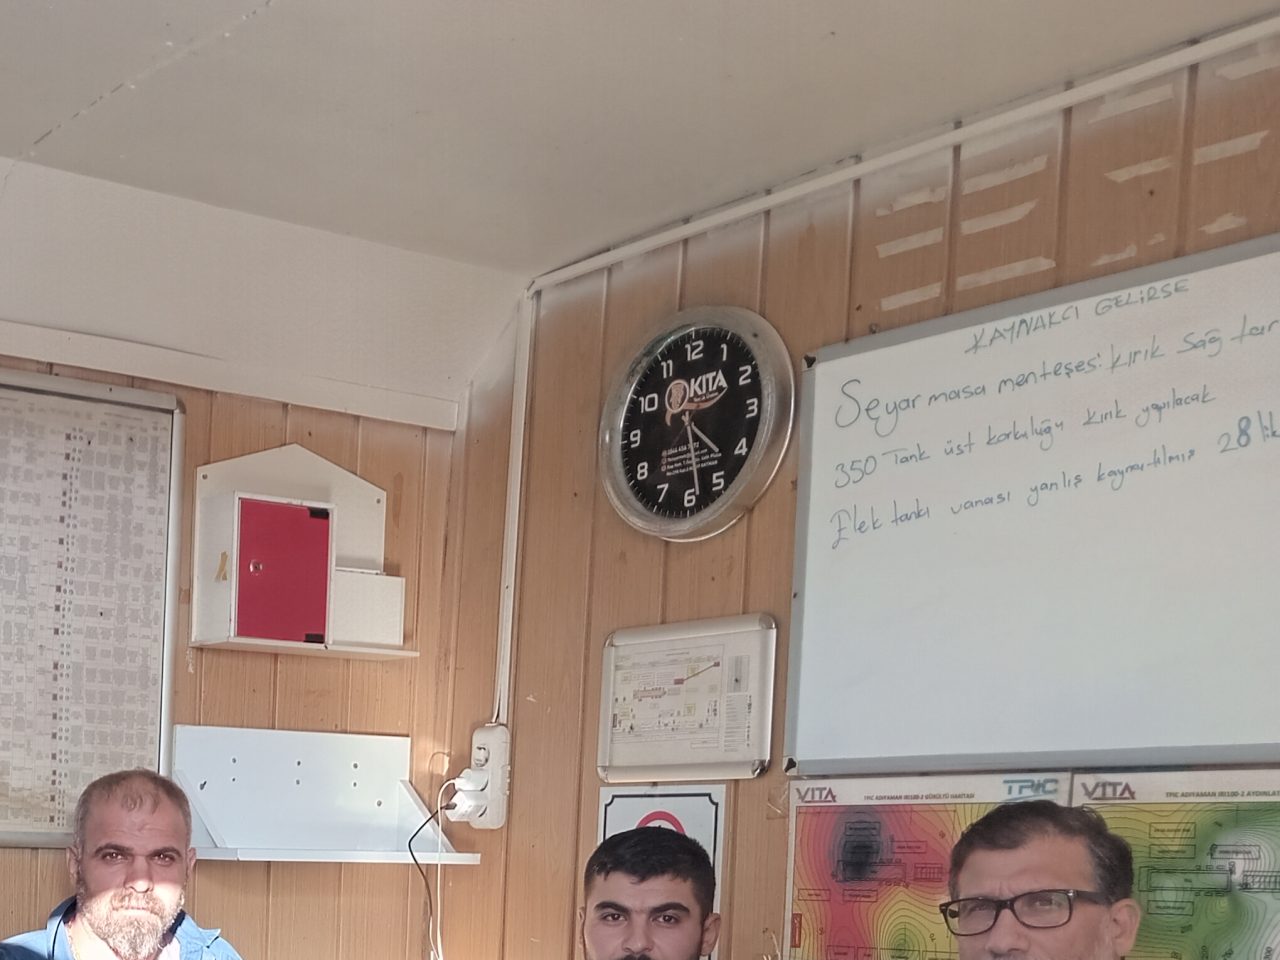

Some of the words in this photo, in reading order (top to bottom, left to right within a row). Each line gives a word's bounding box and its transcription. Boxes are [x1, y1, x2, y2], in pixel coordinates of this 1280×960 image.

[1095, 279, 1190, 316] GELİRSE
[684, 340, 704, 361] 12
[720, 344, 727, 361] 1
[661, 360, 673, 379] 11
[739, 366, 752, 386] 2
[639, 393, 658, 413] 10
[746, 398, 758, 418] 3
[835, 378, 922, 438] Seyar
[928, 383, 986, 406] masa
[630, 429, 641, 448] 9
[1217, 415, 1251, 454] 28
[734, 437, 748, 456] 4
[834, 455, 877, 488] 350
[944, 432, 975, 456] üst
[637, 462, 648, 480] 8
[712, 471, 725, 491] 5
[657, 483, 669, 502] 7
[684, 488, 696, 507] 6
[796, 787, 837, 802] VITA
[1003, 778, 1059, 797] TPIC
[1081, 782, 1136, 801] VITA
